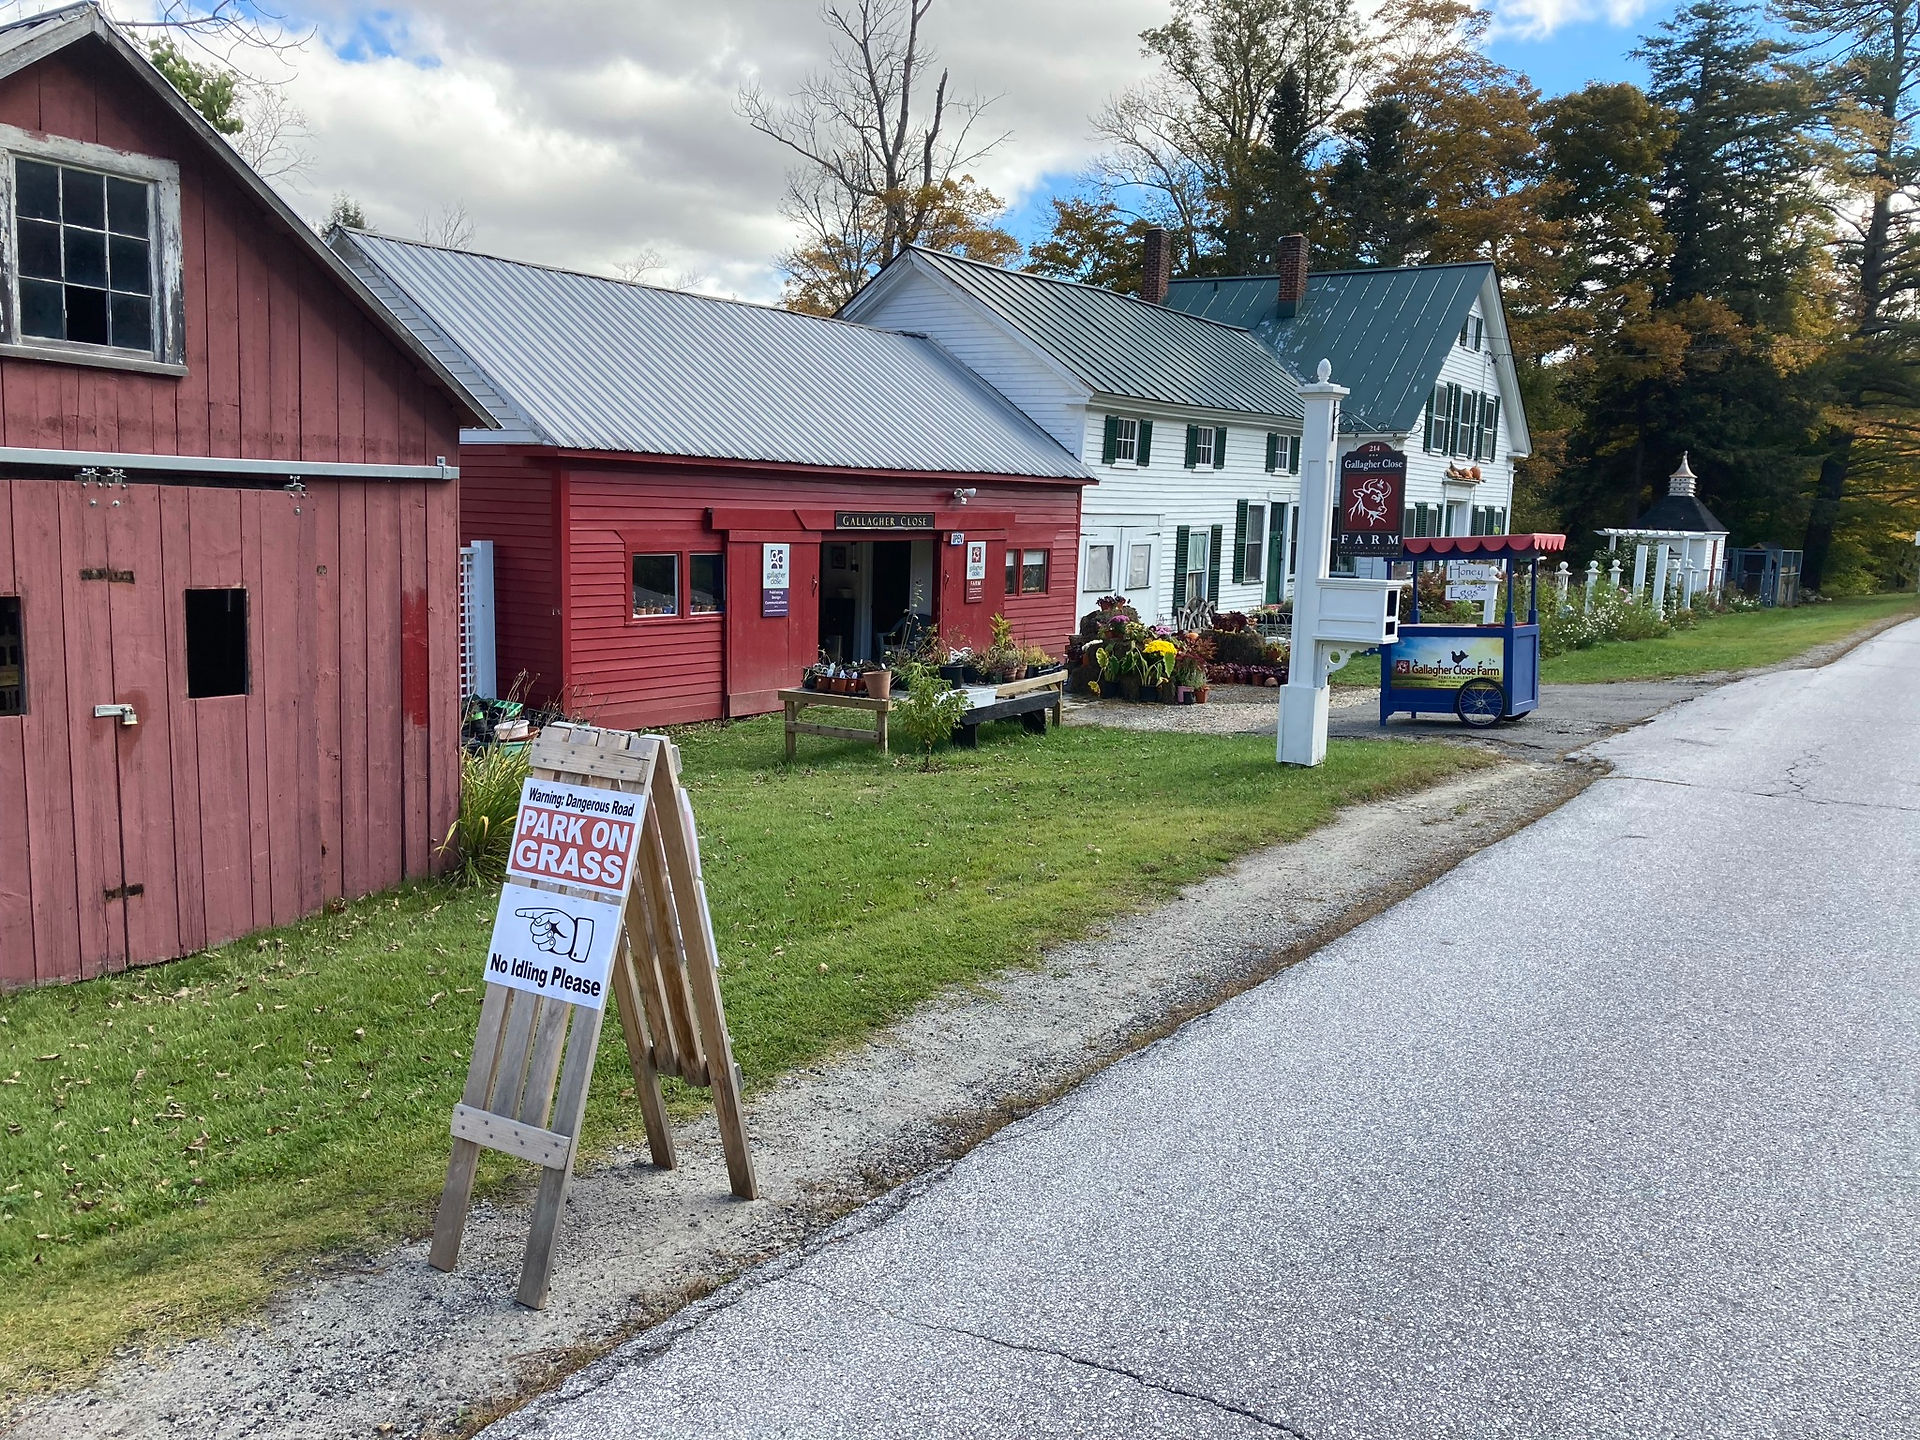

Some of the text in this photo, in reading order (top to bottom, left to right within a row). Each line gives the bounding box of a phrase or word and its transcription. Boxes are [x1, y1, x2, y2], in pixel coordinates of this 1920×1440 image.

[1344, 459, 1403, 471] Gallagher Close
[842, 515, 927, 526] GALLAGHER CLOSE
[1340, 534, 1400, 545] FARM
[1450, 565, 1483, 579] Honey
[1450, 586, 1478, 600] Eggs
[1412, 664, 1499, 676] Gallagher Close Farm
[529, 787, 635, 817] Warning: Dangerous Road
[520, 809, 630, 852] PARK ON
[516, 839, 623, 884] GRASS
[490, 953, 601, 996] No Idling Please
